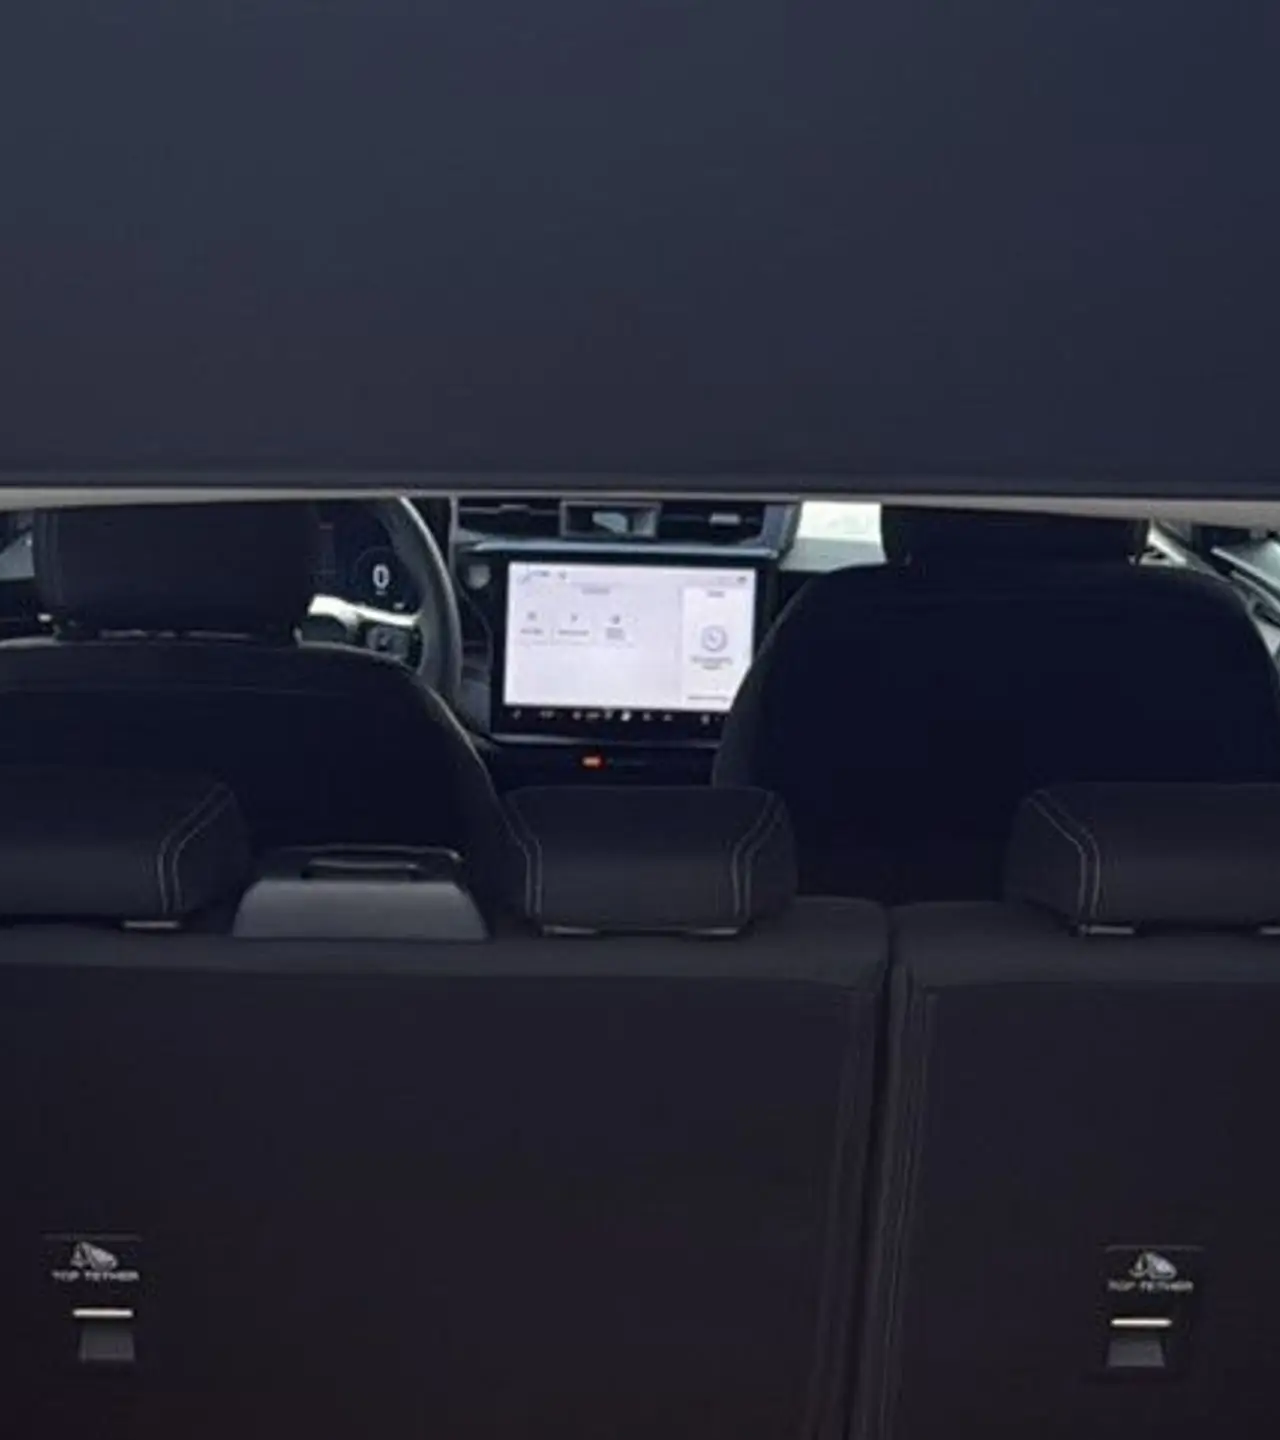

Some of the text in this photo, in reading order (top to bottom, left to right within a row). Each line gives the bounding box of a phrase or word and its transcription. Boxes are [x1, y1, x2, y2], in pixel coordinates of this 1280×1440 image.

[51, 1269, 140, 1282] TOP TETHER
[1107, 1280, 1136, 1292] TOP
